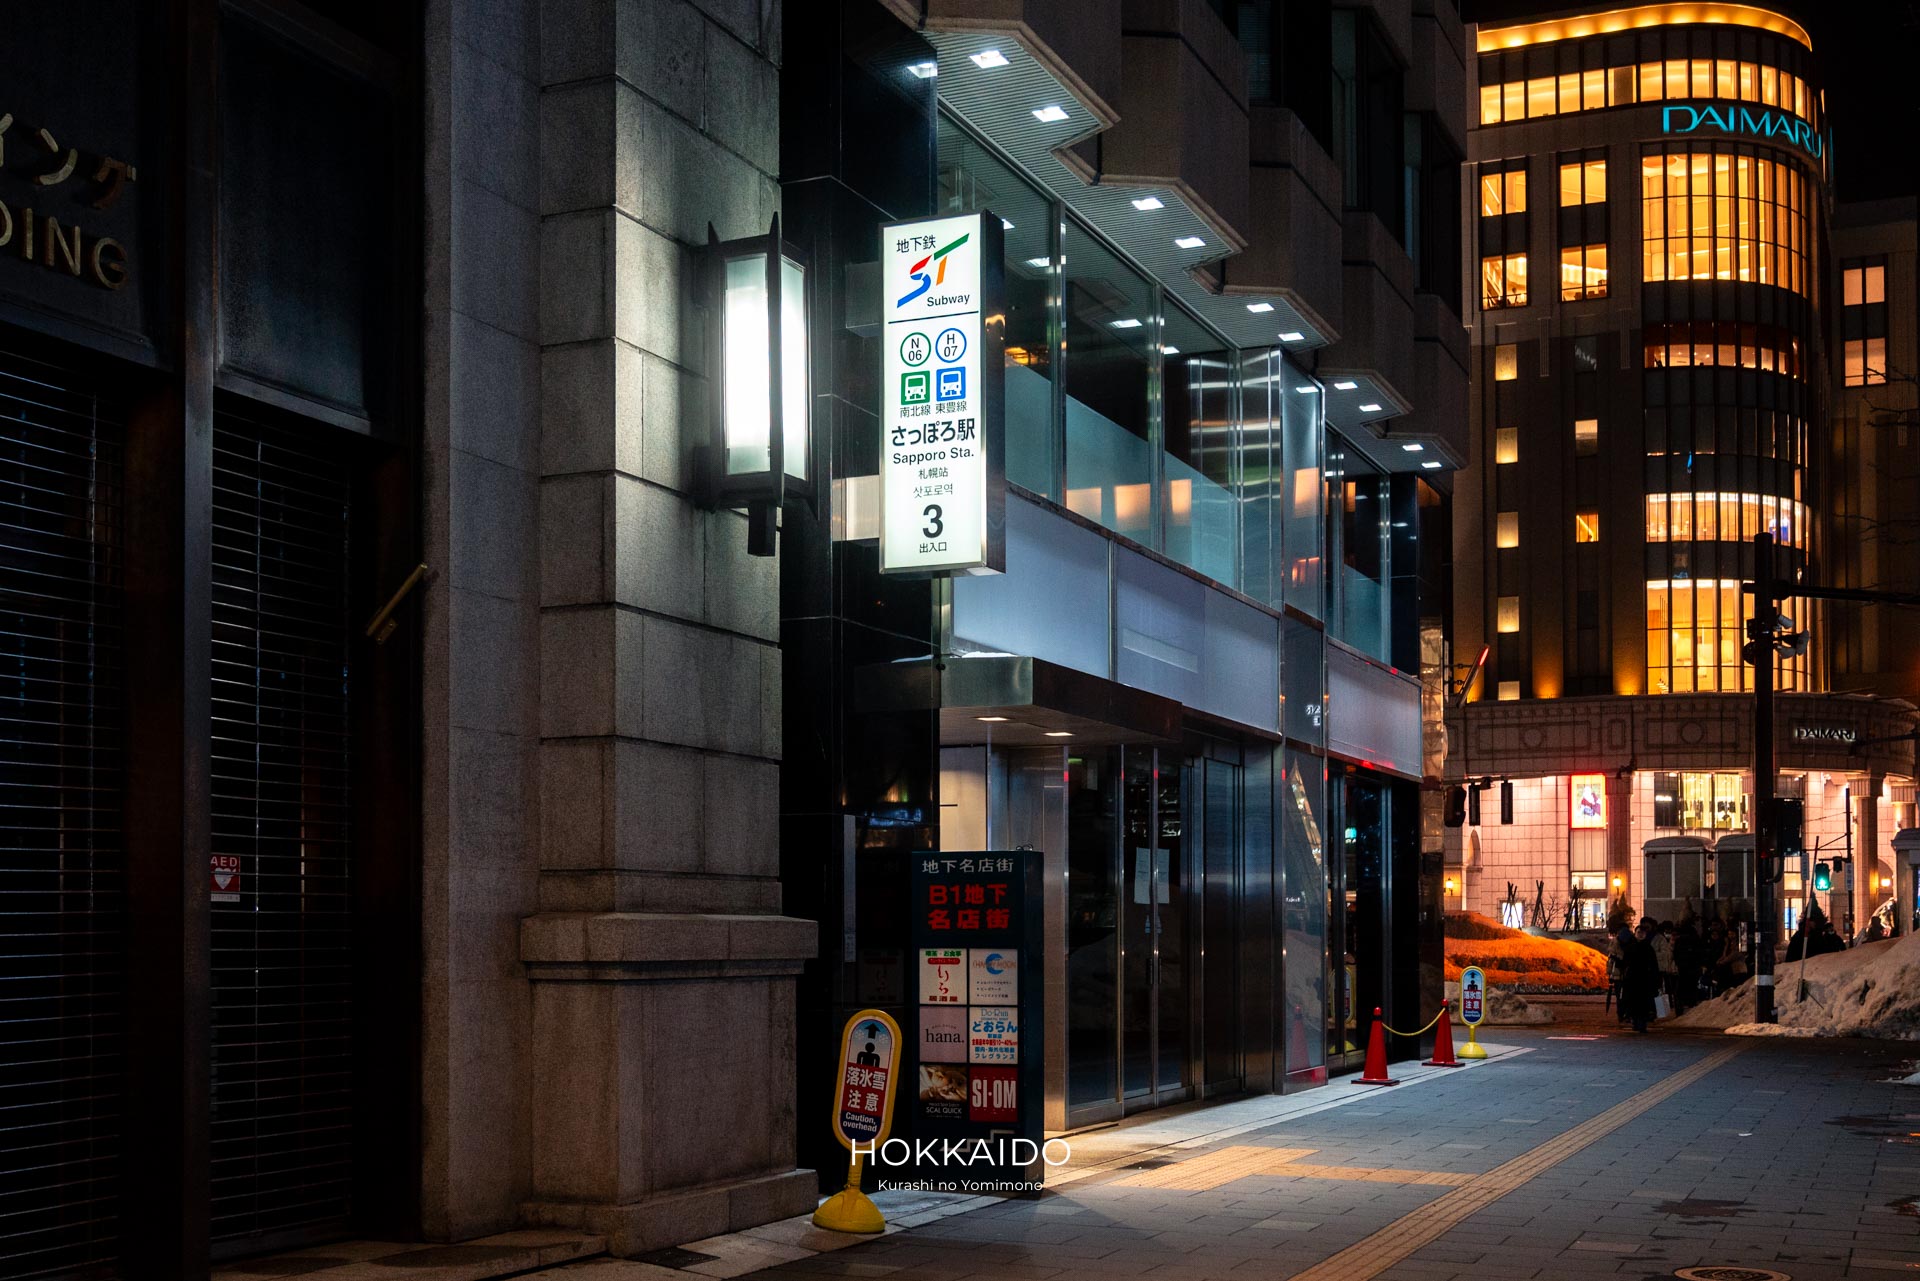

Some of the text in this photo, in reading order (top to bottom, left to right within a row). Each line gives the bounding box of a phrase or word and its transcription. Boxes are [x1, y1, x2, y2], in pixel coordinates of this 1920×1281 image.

[1663, 105, 1822, 159] DAIMARU
[896, 235, 937, 254] 地下鉄
[927, 293, 971, 307] Subway
[911, 338, 920, 349] N
[946, 334, 955, 345] H
[908, 350, 923, 362] 06
[943, 346, 959, 357] 07
[899, 401, 968, 418] 南北線 東豊線
[891, 418, 976, 447] さっぽろ駅
[893, 447, 975, 466] Sapporo Sta.
[918, 467, 949, 480] 札幌站
[913, 483, 954, 498] 삿포로역
[922, 503, 944, 539] 3
[919, 541, 947, 554] 出入口
[1794, 727, 1857, 742] DAIMARU
[210, 856, 238, 867] AED
[921, 857, 1015, 874] 地下名店街
[928, 883, 1008, 905] B1地下
[927, 908, 1010, 930] 名店街
[972, 1021, 1018, 1033] どおらん
[925, 1028, 965, 1044] hana.
[846, 1066, 886, 1091] 落氷雪
[847, 1089, 879, 1112] 注意
[845, 1112, 876, 1125] Caution,
[843, 1121, 878, 1133] overhead
